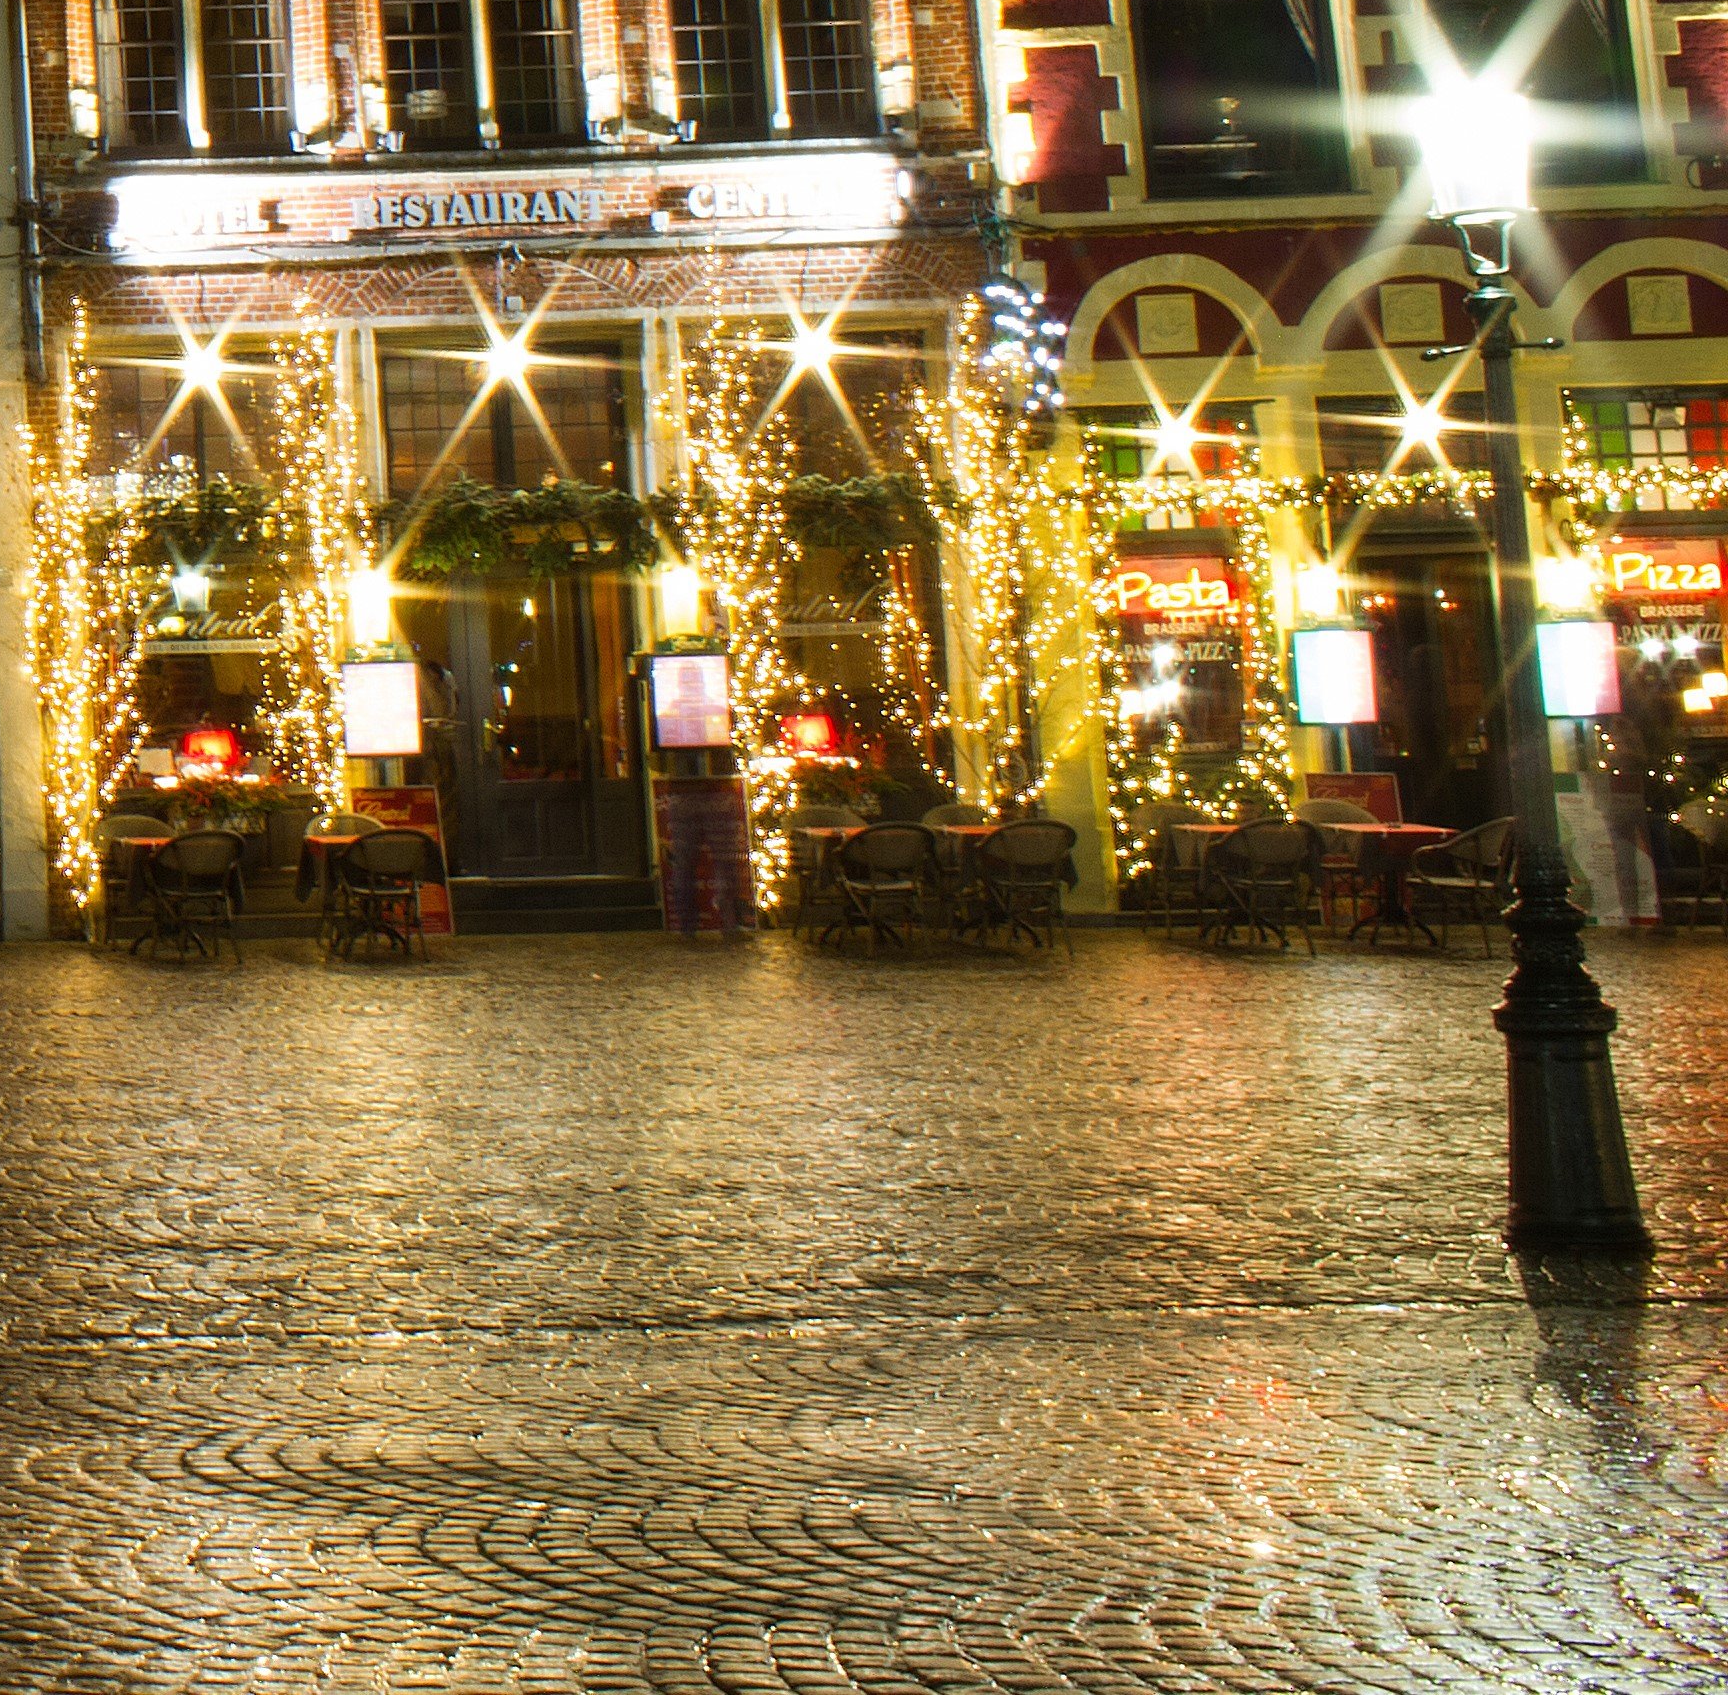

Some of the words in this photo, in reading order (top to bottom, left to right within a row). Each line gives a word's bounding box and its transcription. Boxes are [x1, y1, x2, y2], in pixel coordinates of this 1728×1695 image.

[350, 189, 608, 231] RESTAURANT
[1115, 566, 1231, 611] Pasta
[1611, 551, 1722, 592] Pizza
